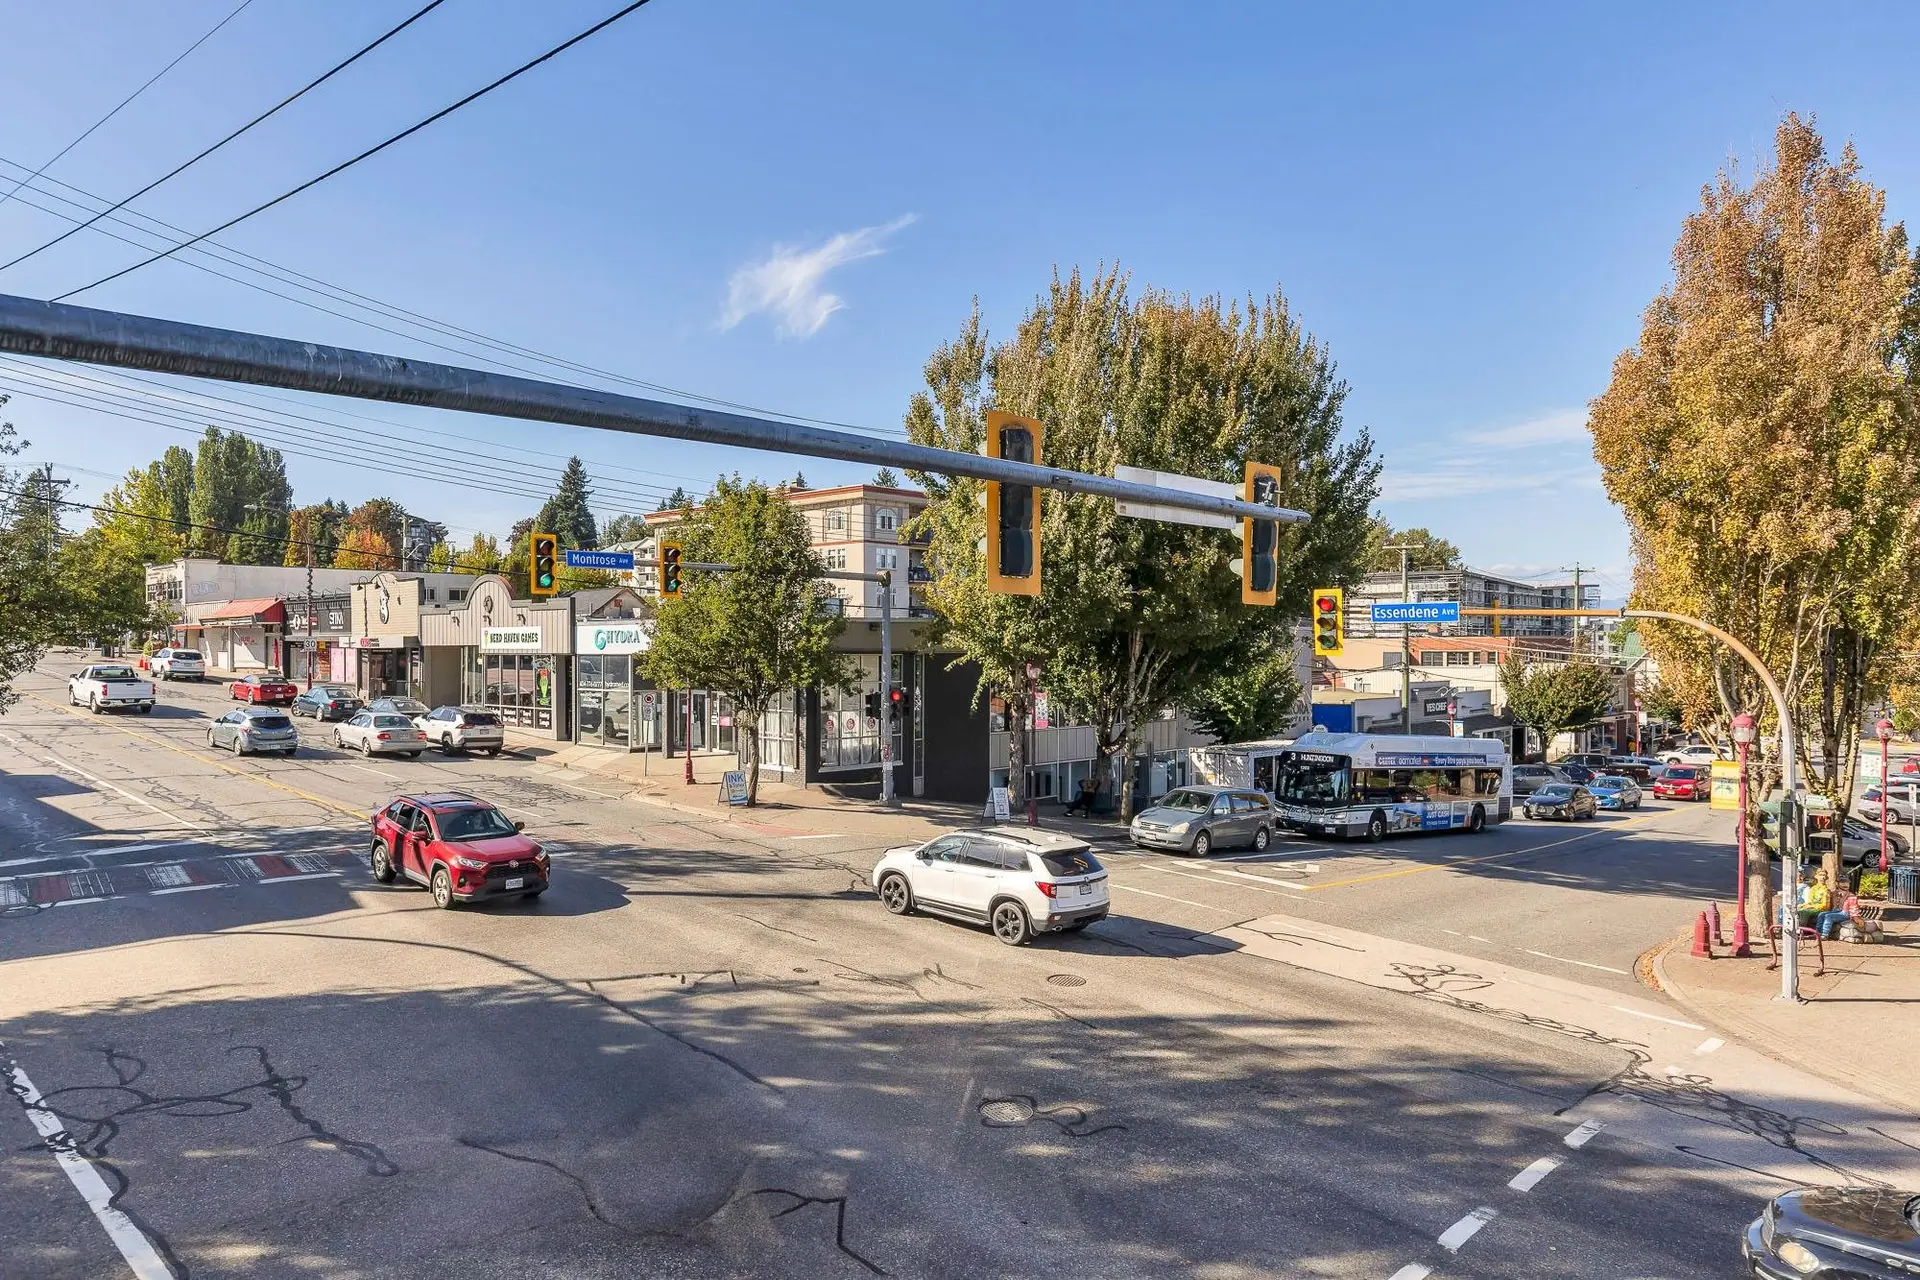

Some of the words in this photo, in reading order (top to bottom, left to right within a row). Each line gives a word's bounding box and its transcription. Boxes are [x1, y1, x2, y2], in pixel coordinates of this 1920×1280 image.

[572, 553, 616, 566] Montrose
[618, 557, 629, 565] Ave
[1374, 605, 1439, 619] Essendene
[1441, 607, 1455, 616] Ave
[489, 632, 503, 644] NERD
[503, 632, 520, 644] HAVEN
[520, 632, 539, 643] GAMES
[606, 629, 641, 645] HYDRA
[305, 640, 315, 648] 30
[1290, 752, 1296, 761] 3
[727, 773, 744, 783] INK
